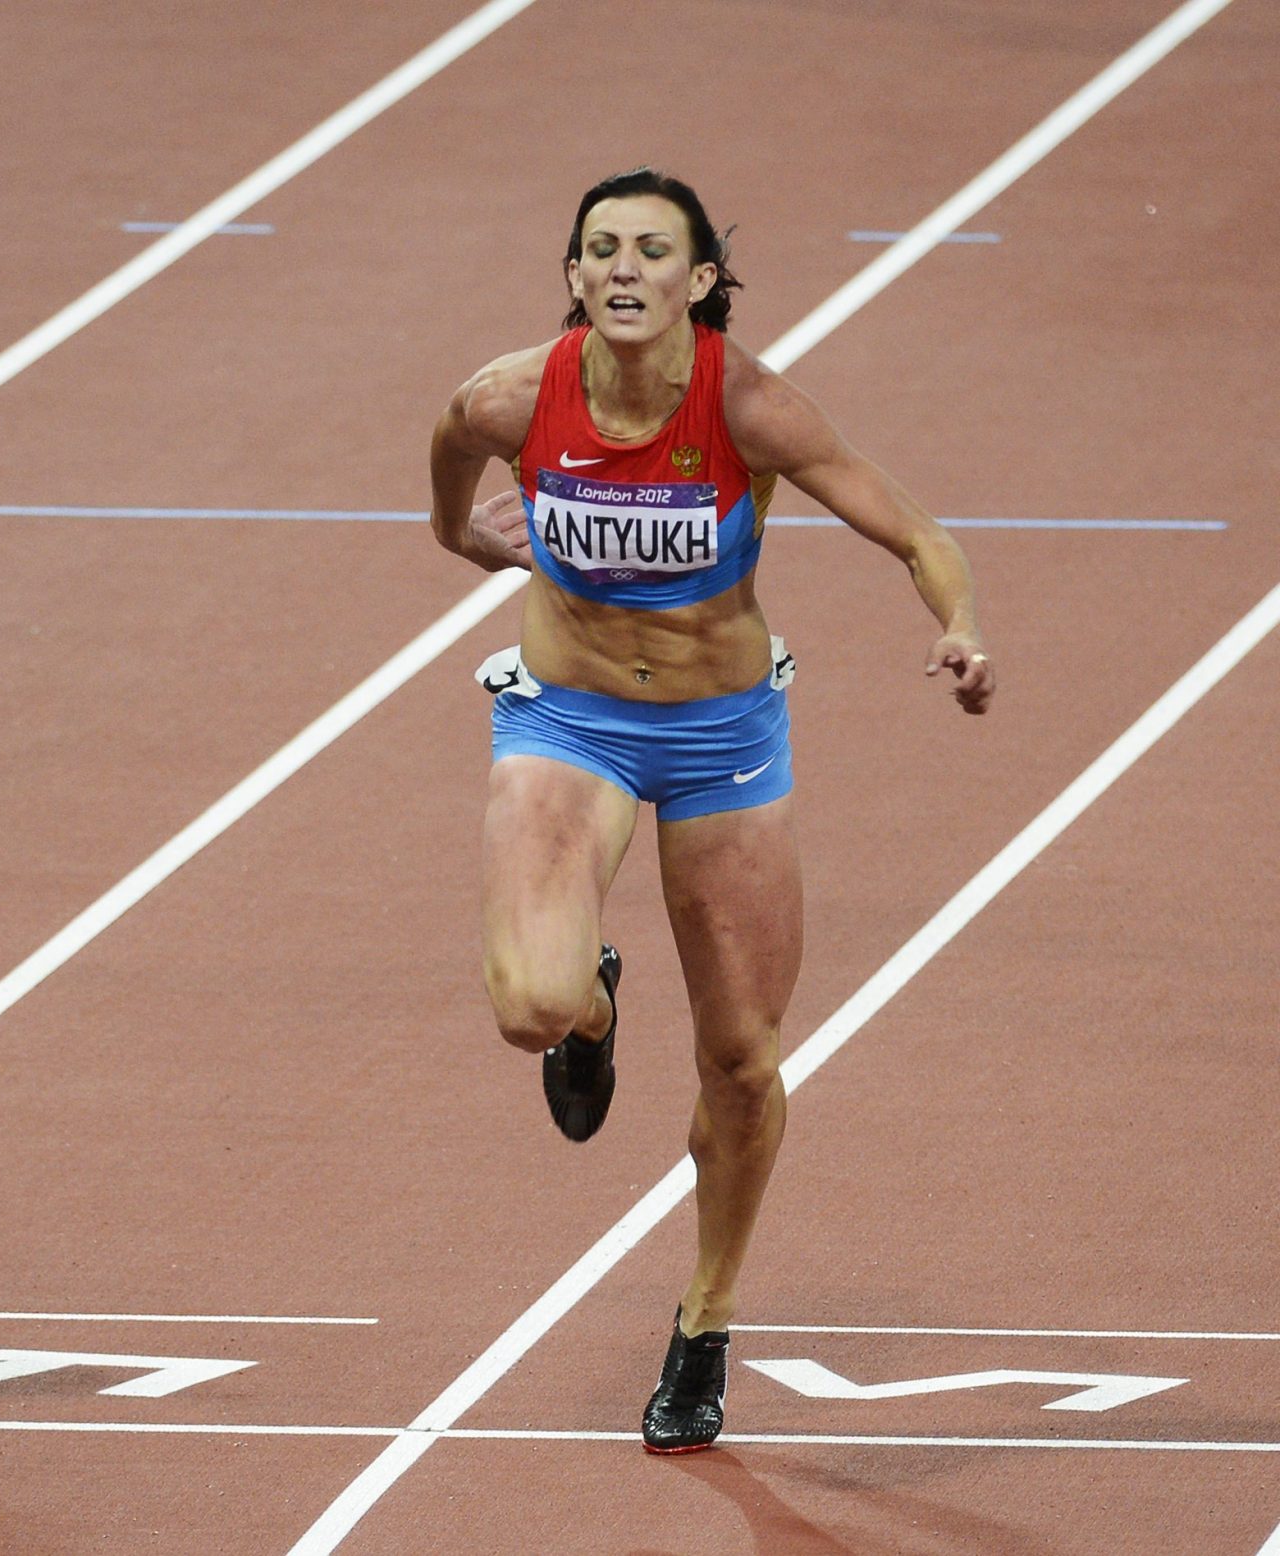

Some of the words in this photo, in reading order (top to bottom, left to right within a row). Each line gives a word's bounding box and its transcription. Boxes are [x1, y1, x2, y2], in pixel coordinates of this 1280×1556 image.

[575, 483, 632, 502] London
[635, 488, 673, 504] 2012
[544, 507, 710, 564] ANTYUKH
